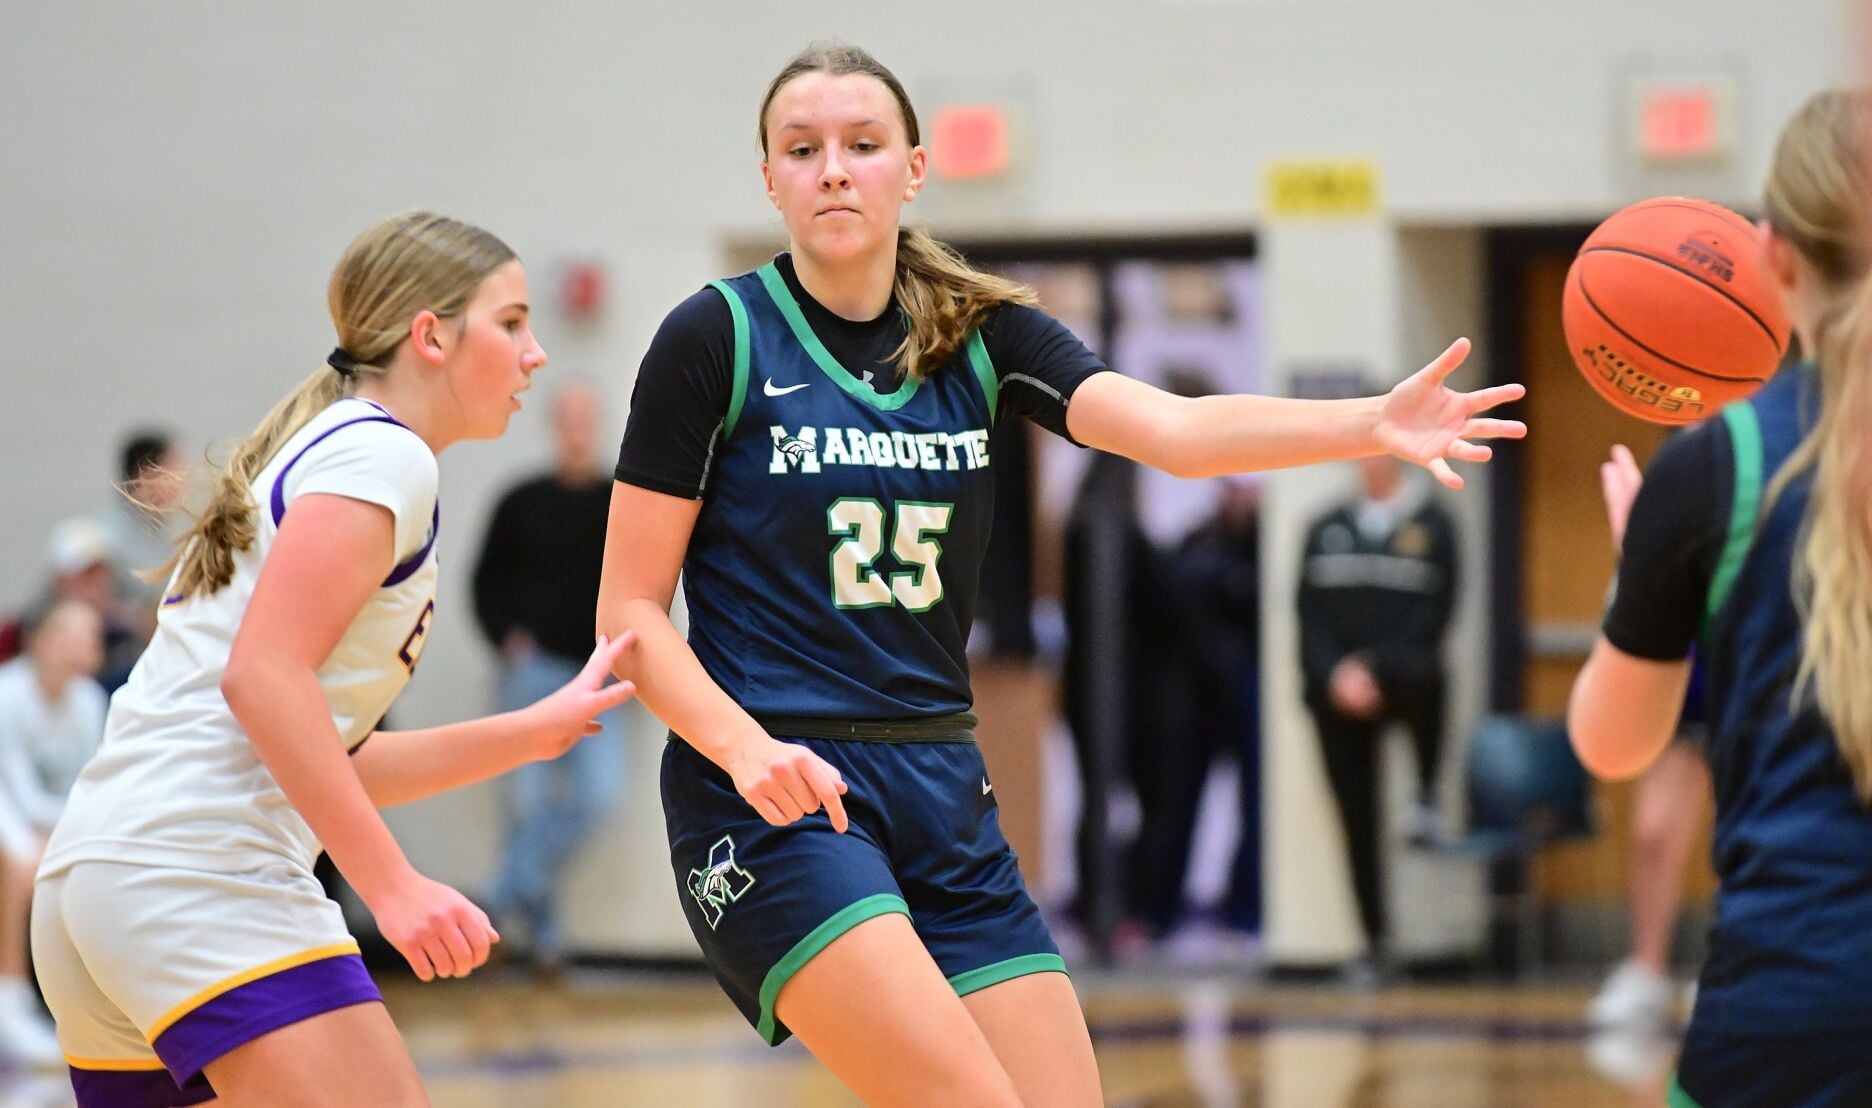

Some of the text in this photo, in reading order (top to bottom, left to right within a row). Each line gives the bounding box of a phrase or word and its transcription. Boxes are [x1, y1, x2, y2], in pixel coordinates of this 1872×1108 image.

[1583, 347, 1704, 412] LEGACY
[769, 425, 990, 474] MARQUETTE
[826, 496, 955, 613] 25
